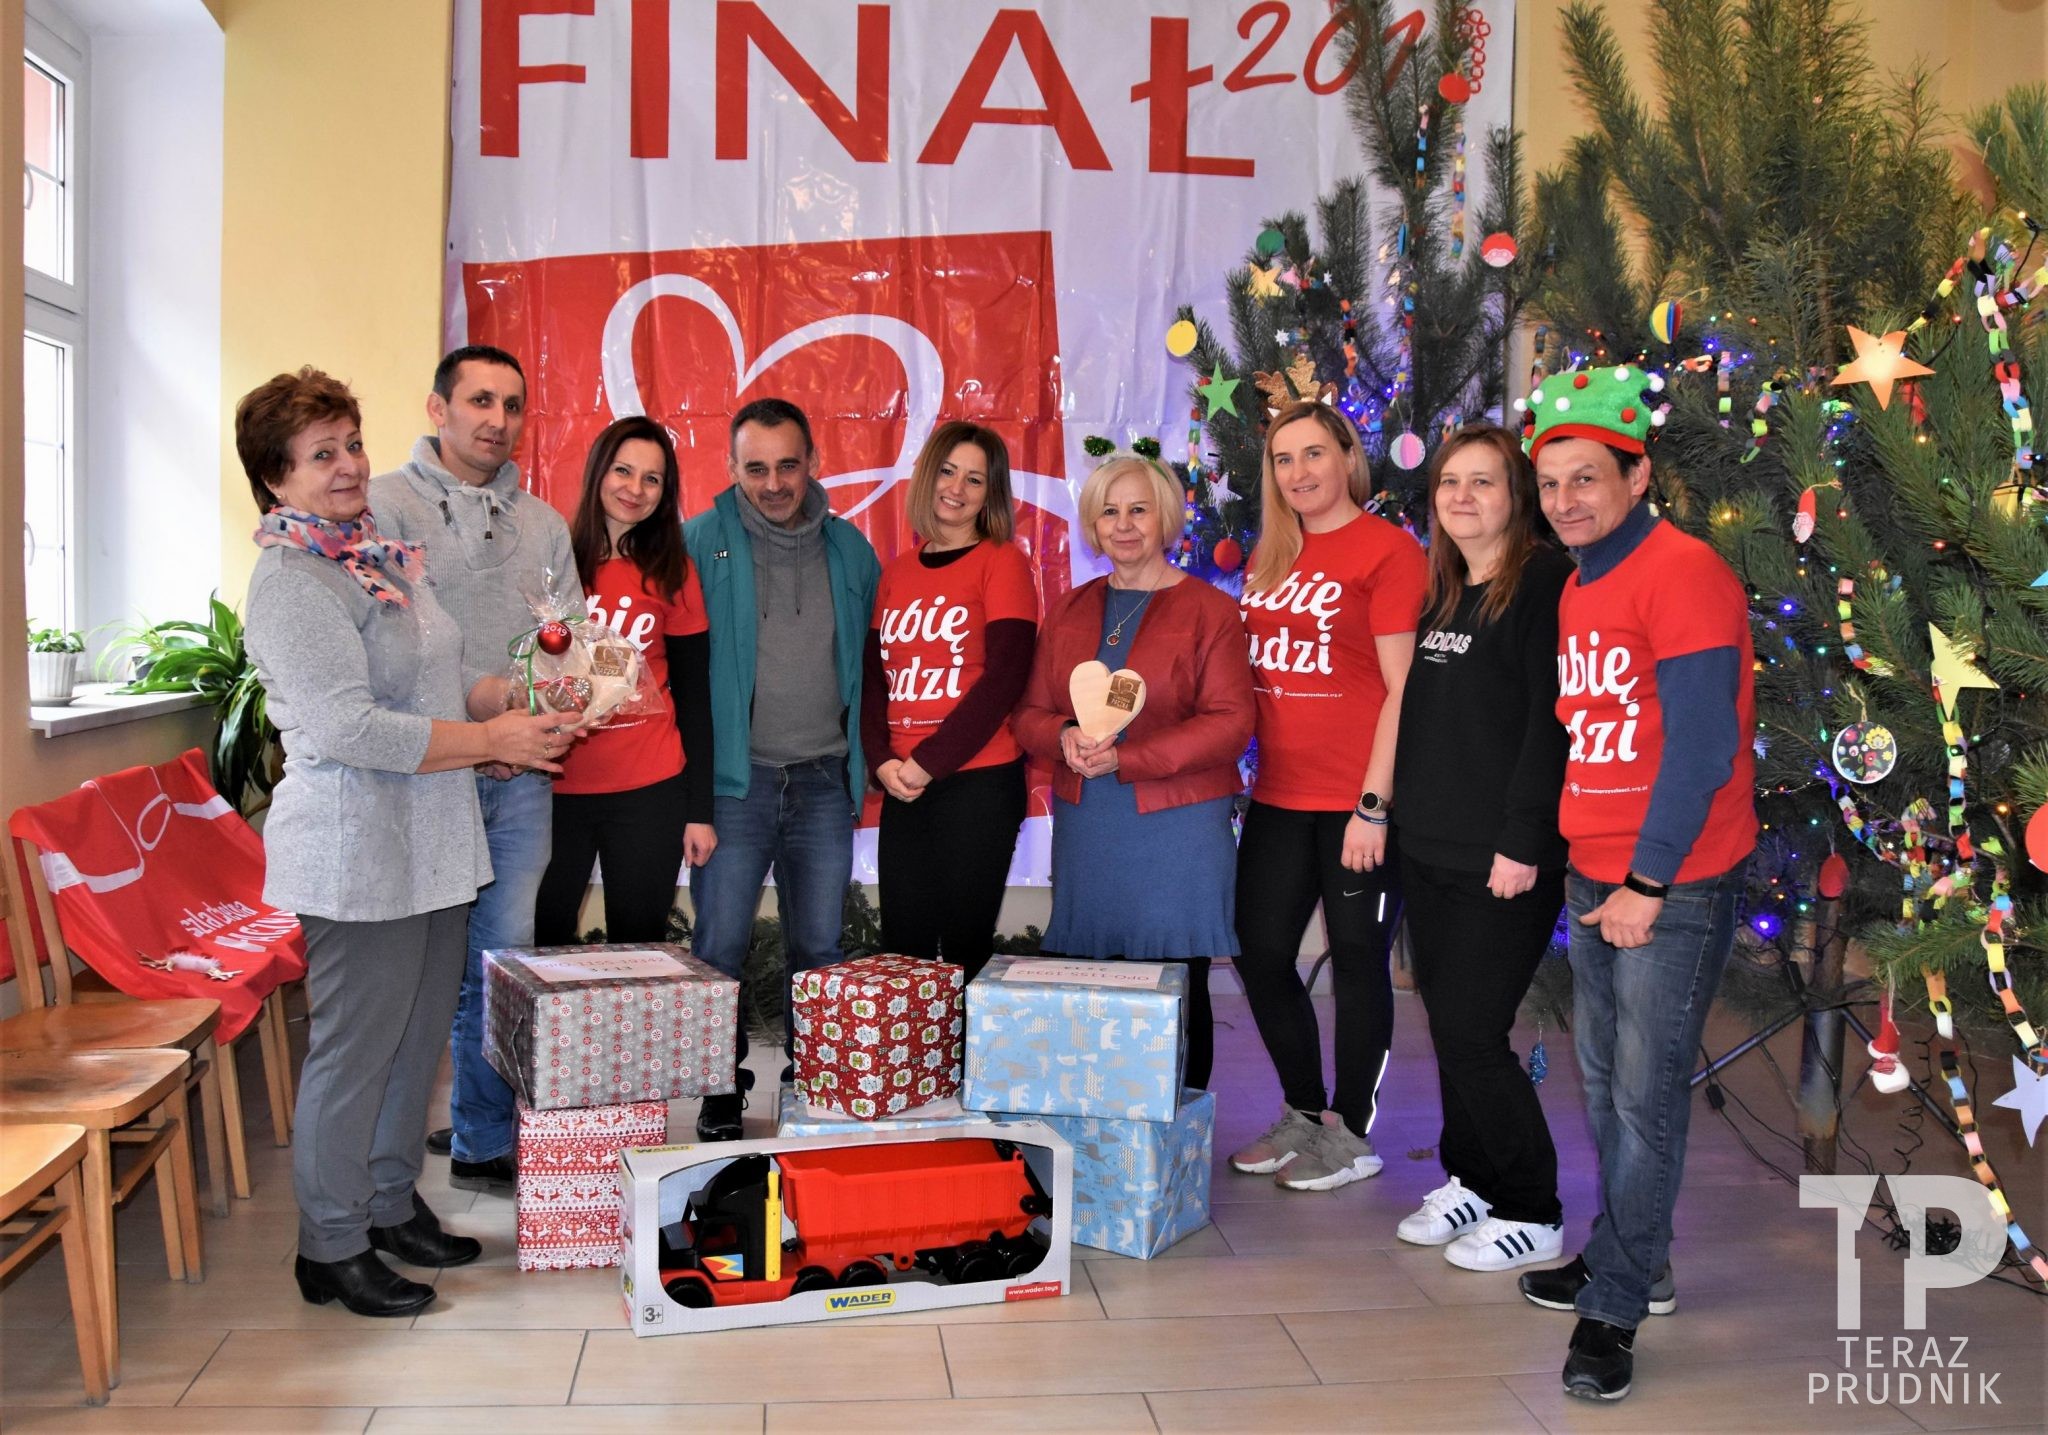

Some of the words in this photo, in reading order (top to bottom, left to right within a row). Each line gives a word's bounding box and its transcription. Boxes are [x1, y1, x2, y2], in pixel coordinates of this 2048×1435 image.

[480, 0, 1254, 178] FINAŁ
[543, 624, 568, 637] 2019
[880, 596, 970, 653] ubię
[1419, 631, 1472, 654] ADIDAS
[1557, 631, 1639, 704] ubię
[1008, 1284, 1060, 1296] www.wader.toys
[830, 1293, 892, 1309] WADER
[644, 1306, 662, 1322] 3+
